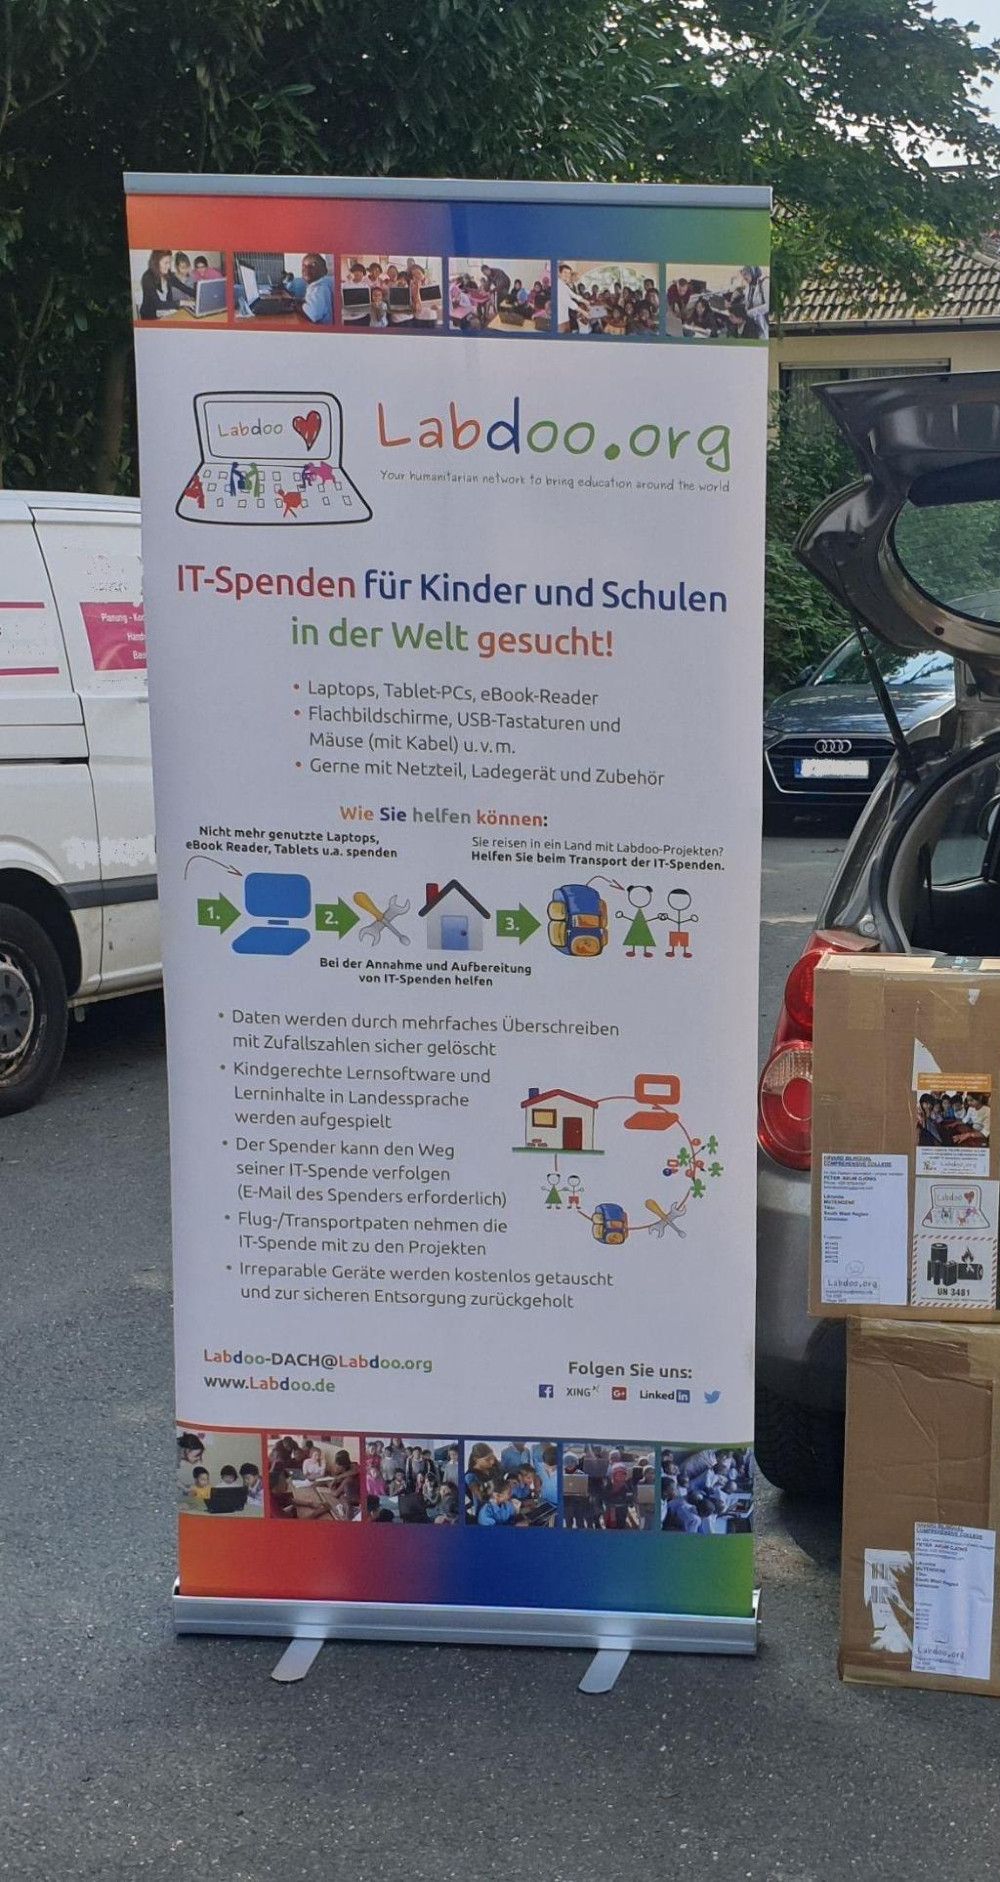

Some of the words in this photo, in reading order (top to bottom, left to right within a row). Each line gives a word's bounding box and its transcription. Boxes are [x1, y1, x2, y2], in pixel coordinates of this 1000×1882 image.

[217, 417, 283, 439] Labdoo
[378, 396, 731, 473] Labdoo.org
[380, 470, 405, 481] Your
[410, 471, 478, 483] humanitarian
[483, 472, 525, 484] network
[531, 475, 541, 485] to
[546, 476, 574, 489] bring
[578, 476, 632, 488] education
[636, 479, 674, 490] around
[679, 480, 695, 491] the
[699, 480, 730, 492] world
[178, 564, 355, 600] IT-Spenden
[365, 569, 412, 600] für
[421, 572, 527, 604] Kinder
[535, 577, 593, 607] und
[602, 580, 726, 612] Schulen
[292, 616, 318, 645] in
[328, 617, 383, 647] der
[391, 621, 468, 651] Welt
[477, 626, 612, 659] gesucht!
[308, 680, 381, 700] Laptops,
[383, 682, 476, 703] Tablet-PCs,
[481, 686, 599, 706] eBook-Reader
[309, 705, 452, 729] Flachbildschirme,
[457, 711, 585, 731] USB-Tastaturen
[590, 717, 620, 733] und
[310, 731, 363, 748] Mäuse
[368, 733, 402, 752] (mit
[407, 734, 458, 755] Kabel)
[310, 758, 360, 774] Gerne
[365, 760, 392, 775] mit
[397, 761, 467, 780] Netzteil,
[472, 763, 556, 782] Ladegerät
[560, 767, 591, 782] und
[596, 768, 665, 785] Zubehör
[340, 805, 374, 821] Wie
[379, 806, 407, 822] Sie
[413, 807, 471, 824] helfen
[476, 809, 548, 827] können:
[200, 826, 231, 837] Nicht
[235, 828, 265, 839] mehr
[269, 829, 323, 842] genutzte
[327, 832, 380, 845] Laptops,
[472, 837, 489, 848] Sie
[492, 838, 527, 849] reisen
[530, 839, 541, 850] in
[544, 840, 561, 850] ein
[564, 841, 592, 851] Land
[595, 842, 614, 852] mit
[617, 843, 724, 857] Labdoo-Projekten?
[185, 839, 223, 851] eBook
[226, 841, 271, 855] Reader,
[274, 843, 319, 856] Tablets
[322, 847, 343, 857] u.a.
[346, 847, 398, 859] spenden
[471, 850, 512, 861] Helfen
[515, 852, 533, 862] Sie
[537, 852, 566, 863] beim
[569, 854, 628, 868] Transport
[631, 856, 651, 867] der
[654, 858, 725, 871] IT-Spenden.
[207, 907, 220, 919] 1.
[324, 912, 338, 924] 2.
[506, 918, 519, 930] 3.
[320, 957, 339, 967] Bei
[342, 957, 362, 968] der
[365, 959, 422, 970] Annahme
[426, 961, 447, 971] und
[451, 961, 531, 977] Aufbereitung
[358, 975, 380, 983] von
[384, 973, 451, 985] IT-Spenden
[455, 975, 493, 986] helfen
[232, 1009, 280, 1025] Daten
[285, 1012, 347, 1029] werden
[351, 1013, 397, 1029] durch
[402, 1015, 498, 1032] mehrfaches
[503, 1015, 619, 1035] Überschreiben
[233, 1033, 260, 1048] mit
[264, 1034, 370, 1052] Zufallszahlen
[375, 1038, 423, 1054] sicher
[427, 1040, 497, 1057] gelöscht
[234, 1061, 342, 1080] Kindgerechte
[347, 1065, 456, 1082] Lernsoftware
[461, 1068, 490, 1083] und
[235, 1085, 325, 1103] Lerninhalte
[330, 1088, 343, 1103] in
[349, 1089, 469, 1108] Landessprache
[234, 1110, 295, 1125] werden
[299, 1111, 392, 1131] aufgespielt
[236, 1137, 266, 1151] Der
[269, 1138, 336, 1155] Spender
[340, 1140, 379, 1155] kann
[384, 1141, 413, 1156] den
[418, 1143, 454, 1160] Weg
[236, 1161, 285, 1176] seiner
[289, 1163, 368, 1180] IT-Spende
[372, 1164, 450, 1184] verfolgen
[238, 1183, 291, 1201] (E-Mail
[296, 1186, 323, 1201] des
[327, 1187, 403, 1205] Spenders
[407, 1189, 506, 1208] erforderlich)
[238, 1210, 409, 1232] Flug-/Transportpaten
[414, 1217, 479, 1232] nehmen
[483, 1218, 507, 1233] die
[239, 1234, 317, 1252] IT-Spende
[321, 1238, 348, 1252] mit
[352, 1242, 369, 1253] zu
[374, 1238, 404, 1253] den
[409, 1240, 486, 1257] Projekten
[240, 1262, 327, 1279] Irreparable
[332, 1265, 386, 1280] Geräte
[389, 1266, 450, 1281] werden
[455, 1268, 531, 1284] kostenlos
[534, 1271, 614, 1287] getauscht
[241, 1286, 270, 1301] und
[274, 1289, 300, 1304] zur
[303, 1286, 369, 1304] sicheren
[375, 1289, 466, 1308] Entsorgung
[470, 1289, 574, 1310] zurückgeholt
[204, 1349, 432, 1373] Labdoo-DACH@Labdoo.org
[569, 1361, 625, 1378] Folgen
[630, 1363, 654, 1377] Sie
[659, 1367, 692, 1379] uns:
[203, 1376, 335, 1392] www.Labdoo.de
[566, 1386, 592, 1398] XING
